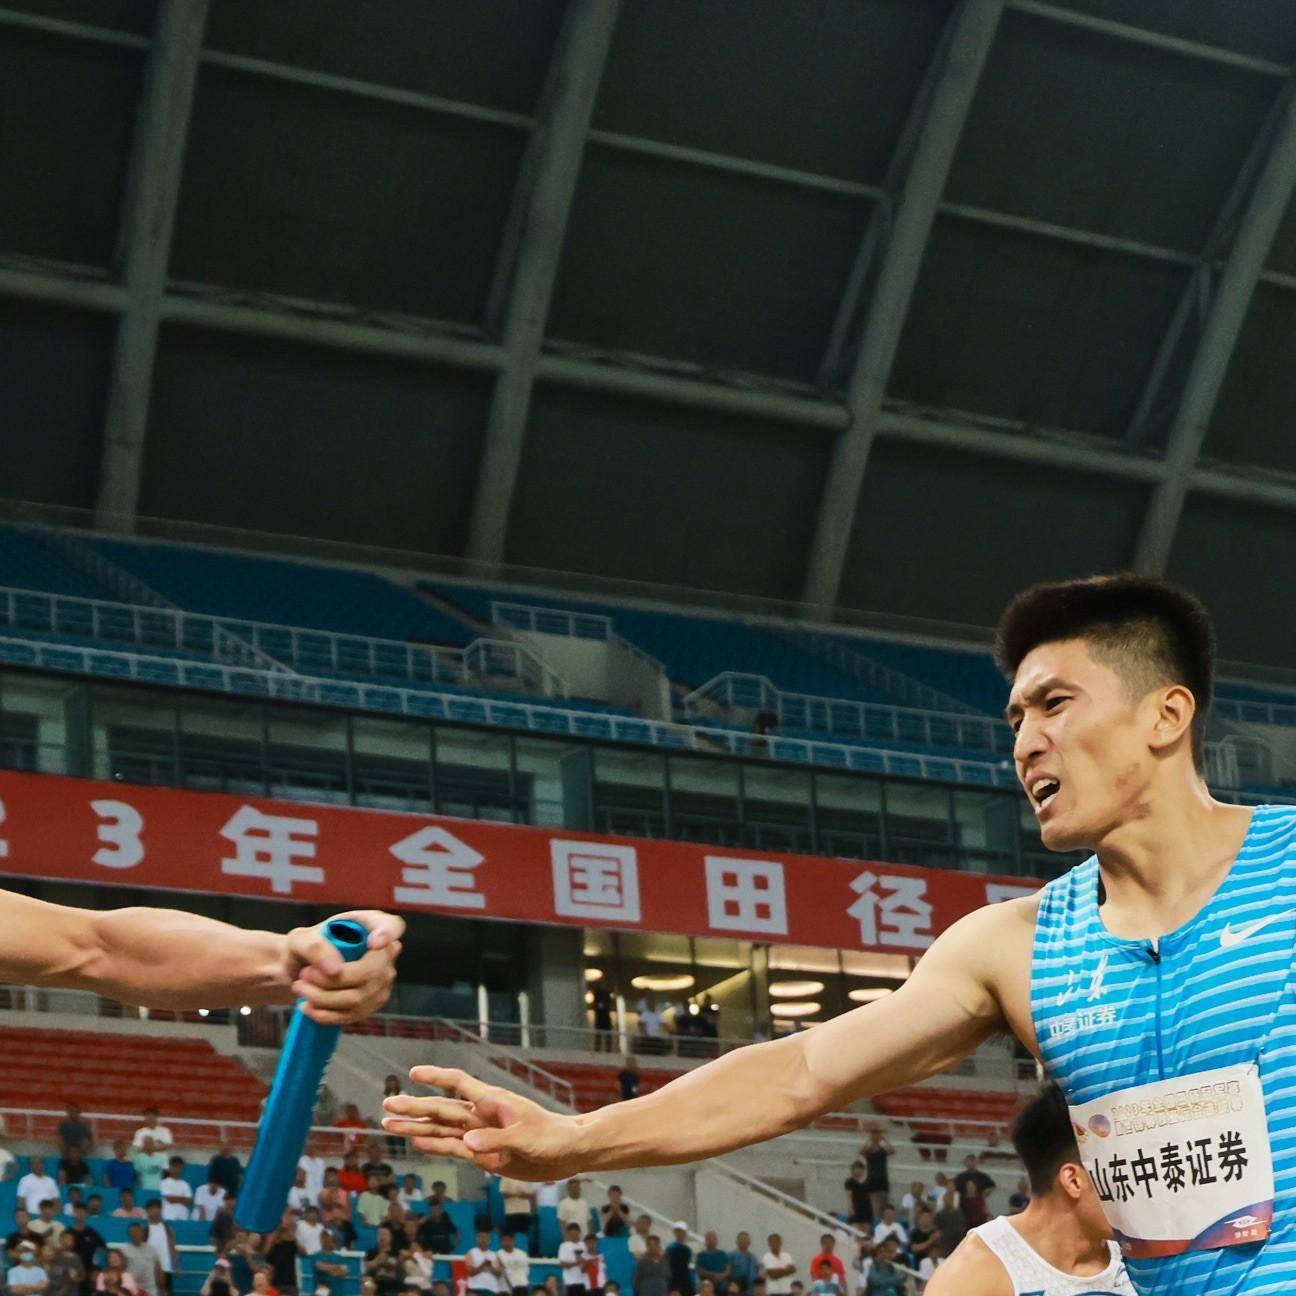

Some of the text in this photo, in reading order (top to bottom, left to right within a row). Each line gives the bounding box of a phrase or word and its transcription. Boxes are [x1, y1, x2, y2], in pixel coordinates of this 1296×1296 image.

[1089, 1130, 1249, 1203] 山东中泰证券
